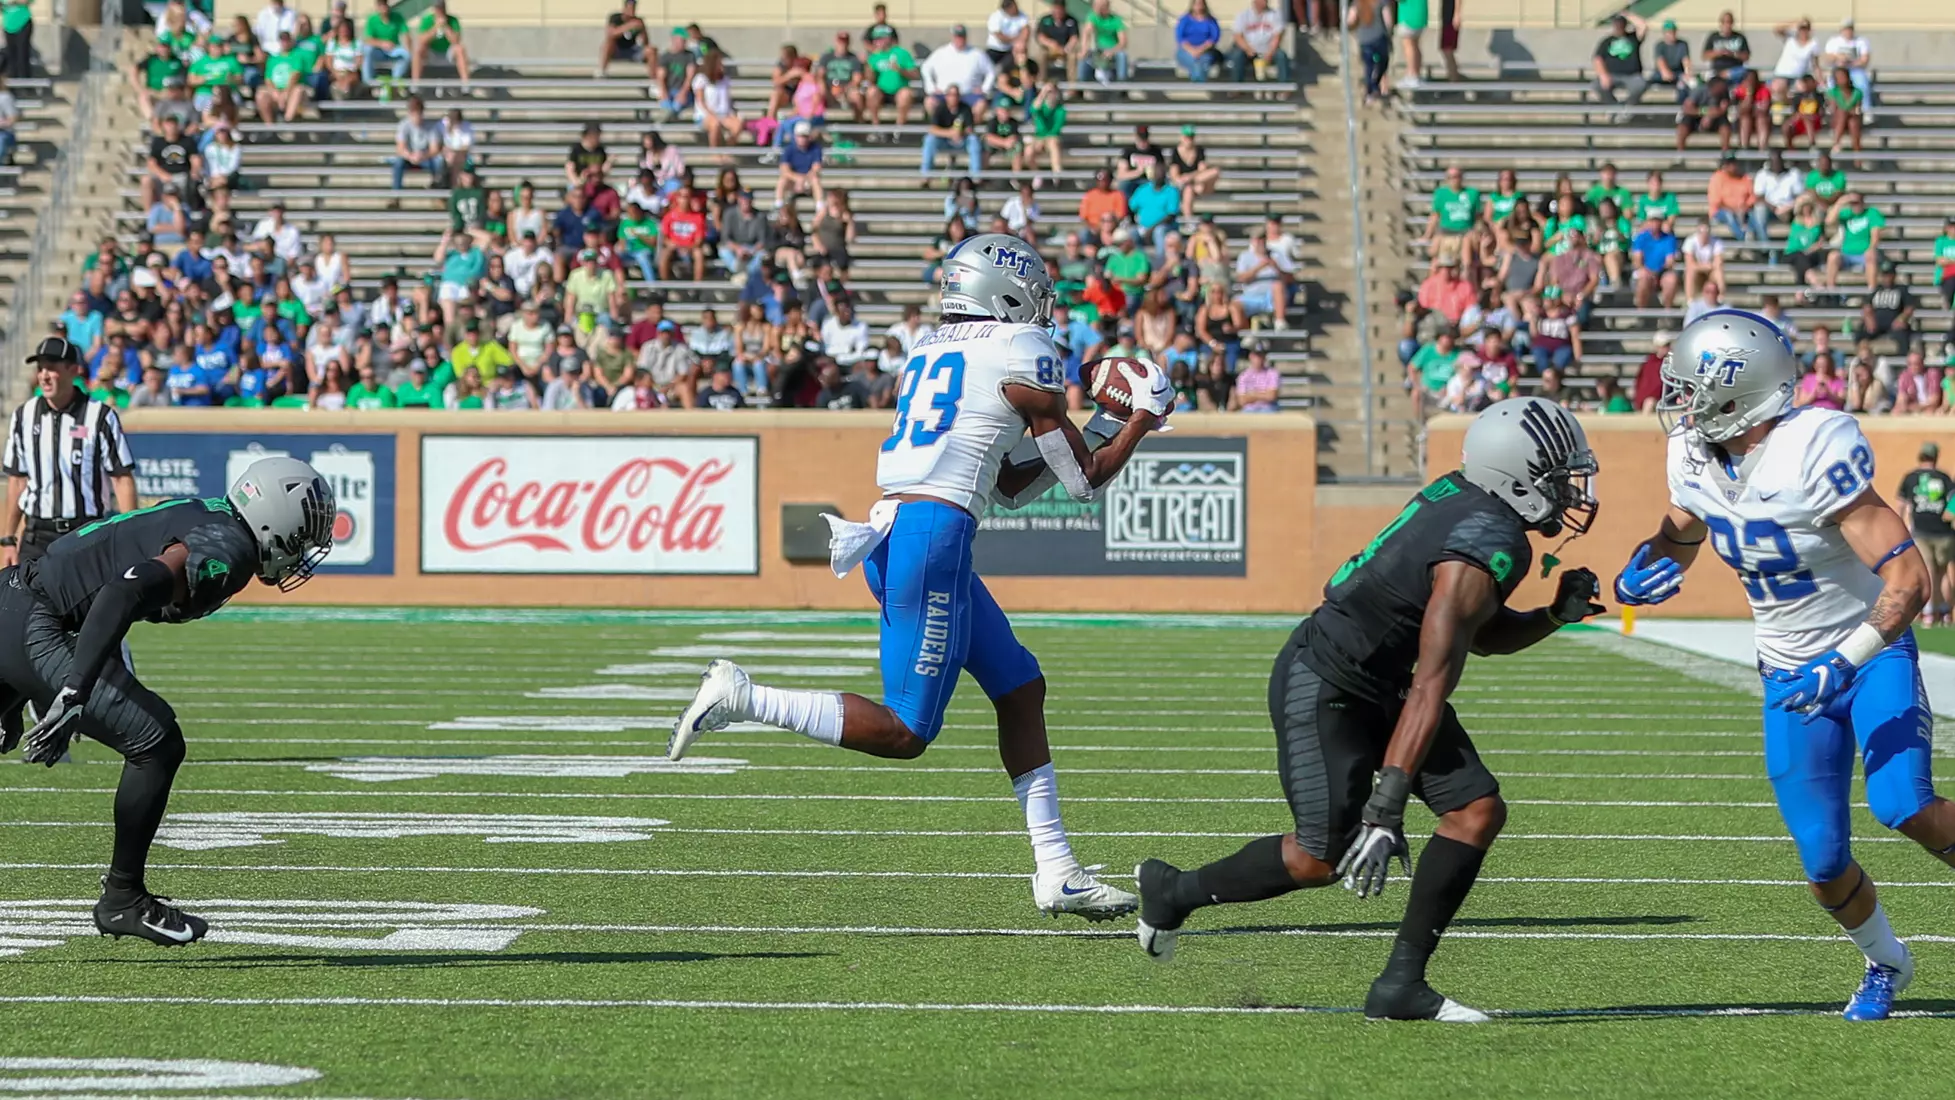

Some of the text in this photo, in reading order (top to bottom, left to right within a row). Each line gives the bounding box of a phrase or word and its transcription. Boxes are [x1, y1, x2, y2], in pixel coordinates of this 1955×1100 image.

[992, 246, 1033, 278] MT
[881, 351, 967, 453] 83
[72, 449, 82, 465] C
[139, 458, 200, 477] TASTE.
[1825, 445, 1874, 497] 82
[136, 477, 200, 495] ILLING.
[331, 473, 368, 499] ite
[443, 456, 735, 553] Coca-Cola
[1114, 492, 1234, 543] RETREAT
[1489, 551, 1513, 581] 9
[1704, 515, 1819, 601] 82
[914, 591, 950, 677] RAIDERS
